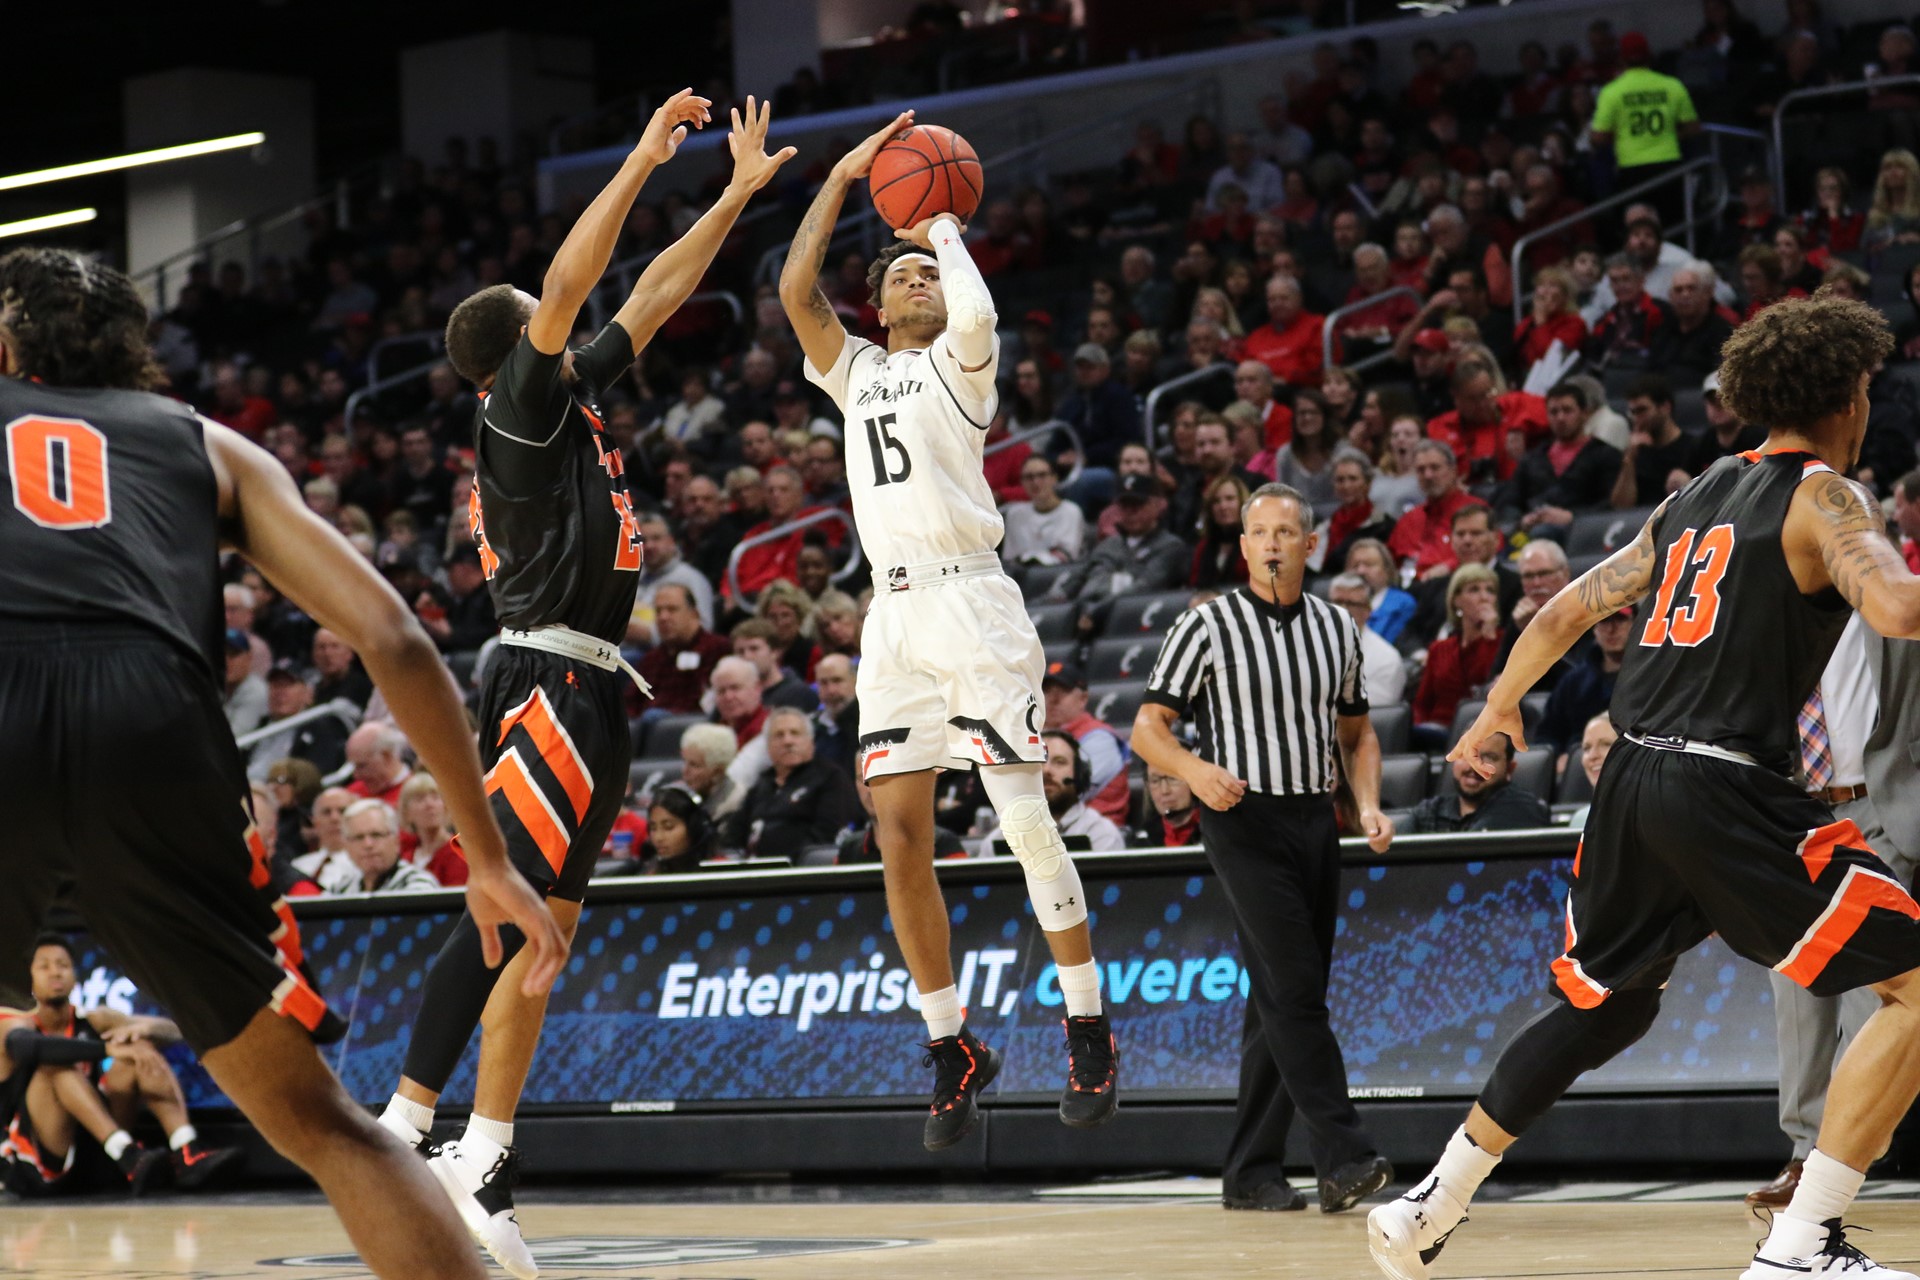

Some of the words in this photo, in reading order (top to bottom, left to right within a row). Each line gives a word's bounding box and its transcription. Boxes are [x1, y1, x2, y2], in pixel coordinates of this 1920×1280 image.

[6, 414, 111, 530] 0
[864, 412, 912, 487] 15
[1639, 523, 1735, 648] 13
[958, 950, 1018, 1016] IT,
[1036, 955, 1251, 1004] cvere
[1347, 1086, 1424, 1099] DAKTRONICS
